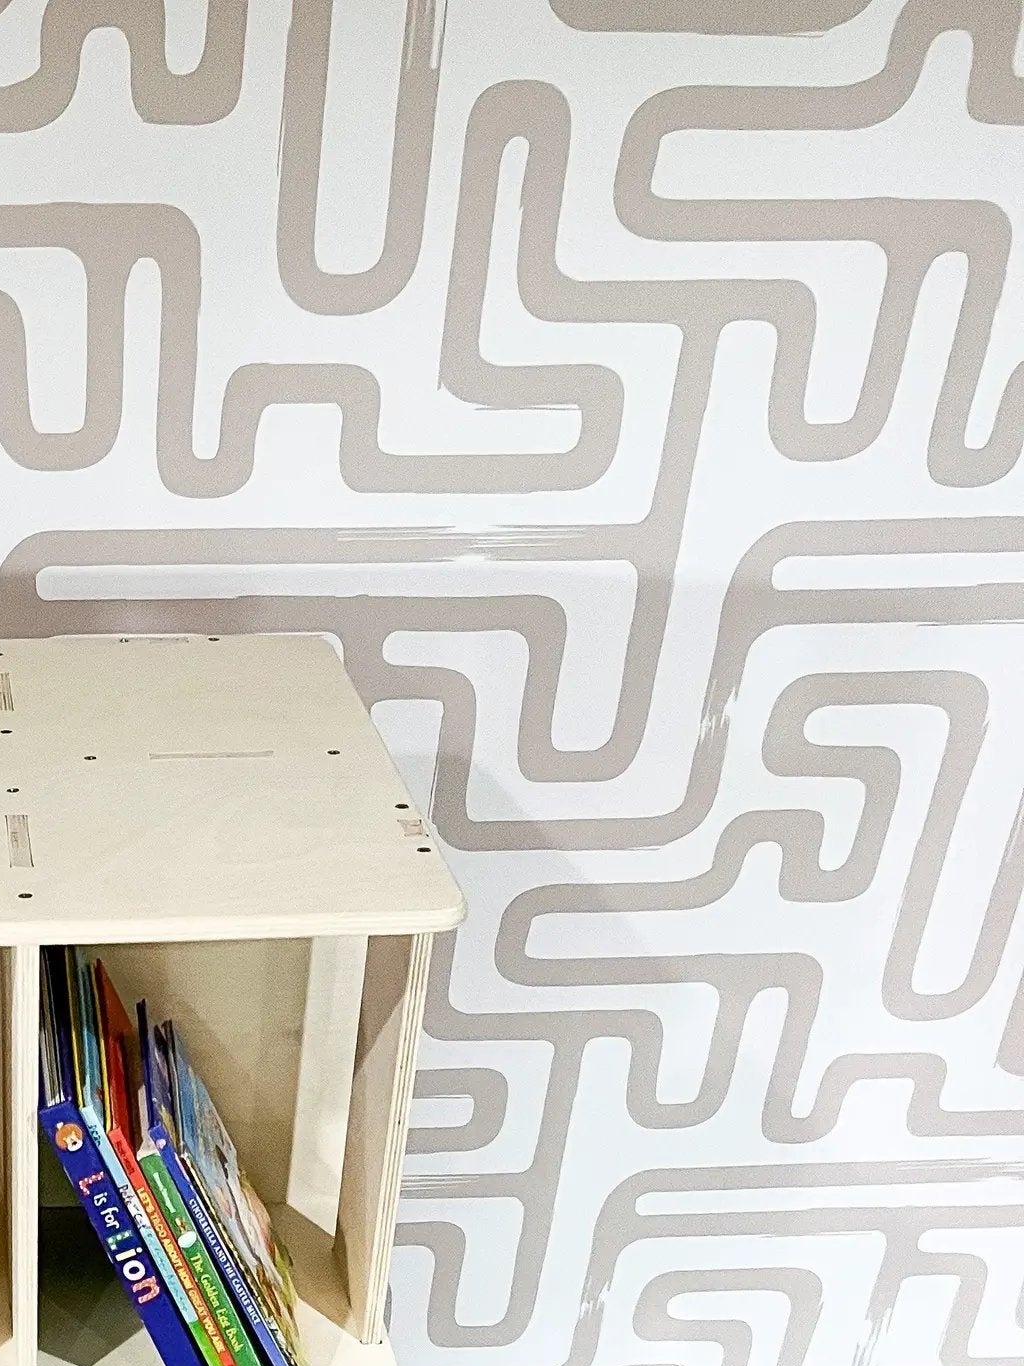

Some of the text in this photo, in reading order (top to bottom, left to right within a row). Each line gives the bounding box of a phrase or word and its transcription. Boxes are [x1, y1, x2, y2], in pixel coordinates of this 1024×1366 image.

[79, 1171, 105, 1195] L
[94, 1192, 108, 1206] is
[118, 1184, 135, 1205] Pete
[99, 1206, 120, 1230] for
[106, 1230, 161, 1304] Lion
[136, 1187, 154, 1213] LET'S
[149, 1213, 167, 1239] TACO
[160, 1236, 183, 1269] ABOUT
[176, 1267, 193, 1290] HOW
[187, 1288, 207, 1317] GREAT
[200, 1315, 217, 1337] YOU
[210, 1334, 225, 1353] ARE
[189, 1198, 261, 1324] CINDERELLA AND THE CASTLE MICE
[190, 1253, 244, 1352] The Golden Egg Book
